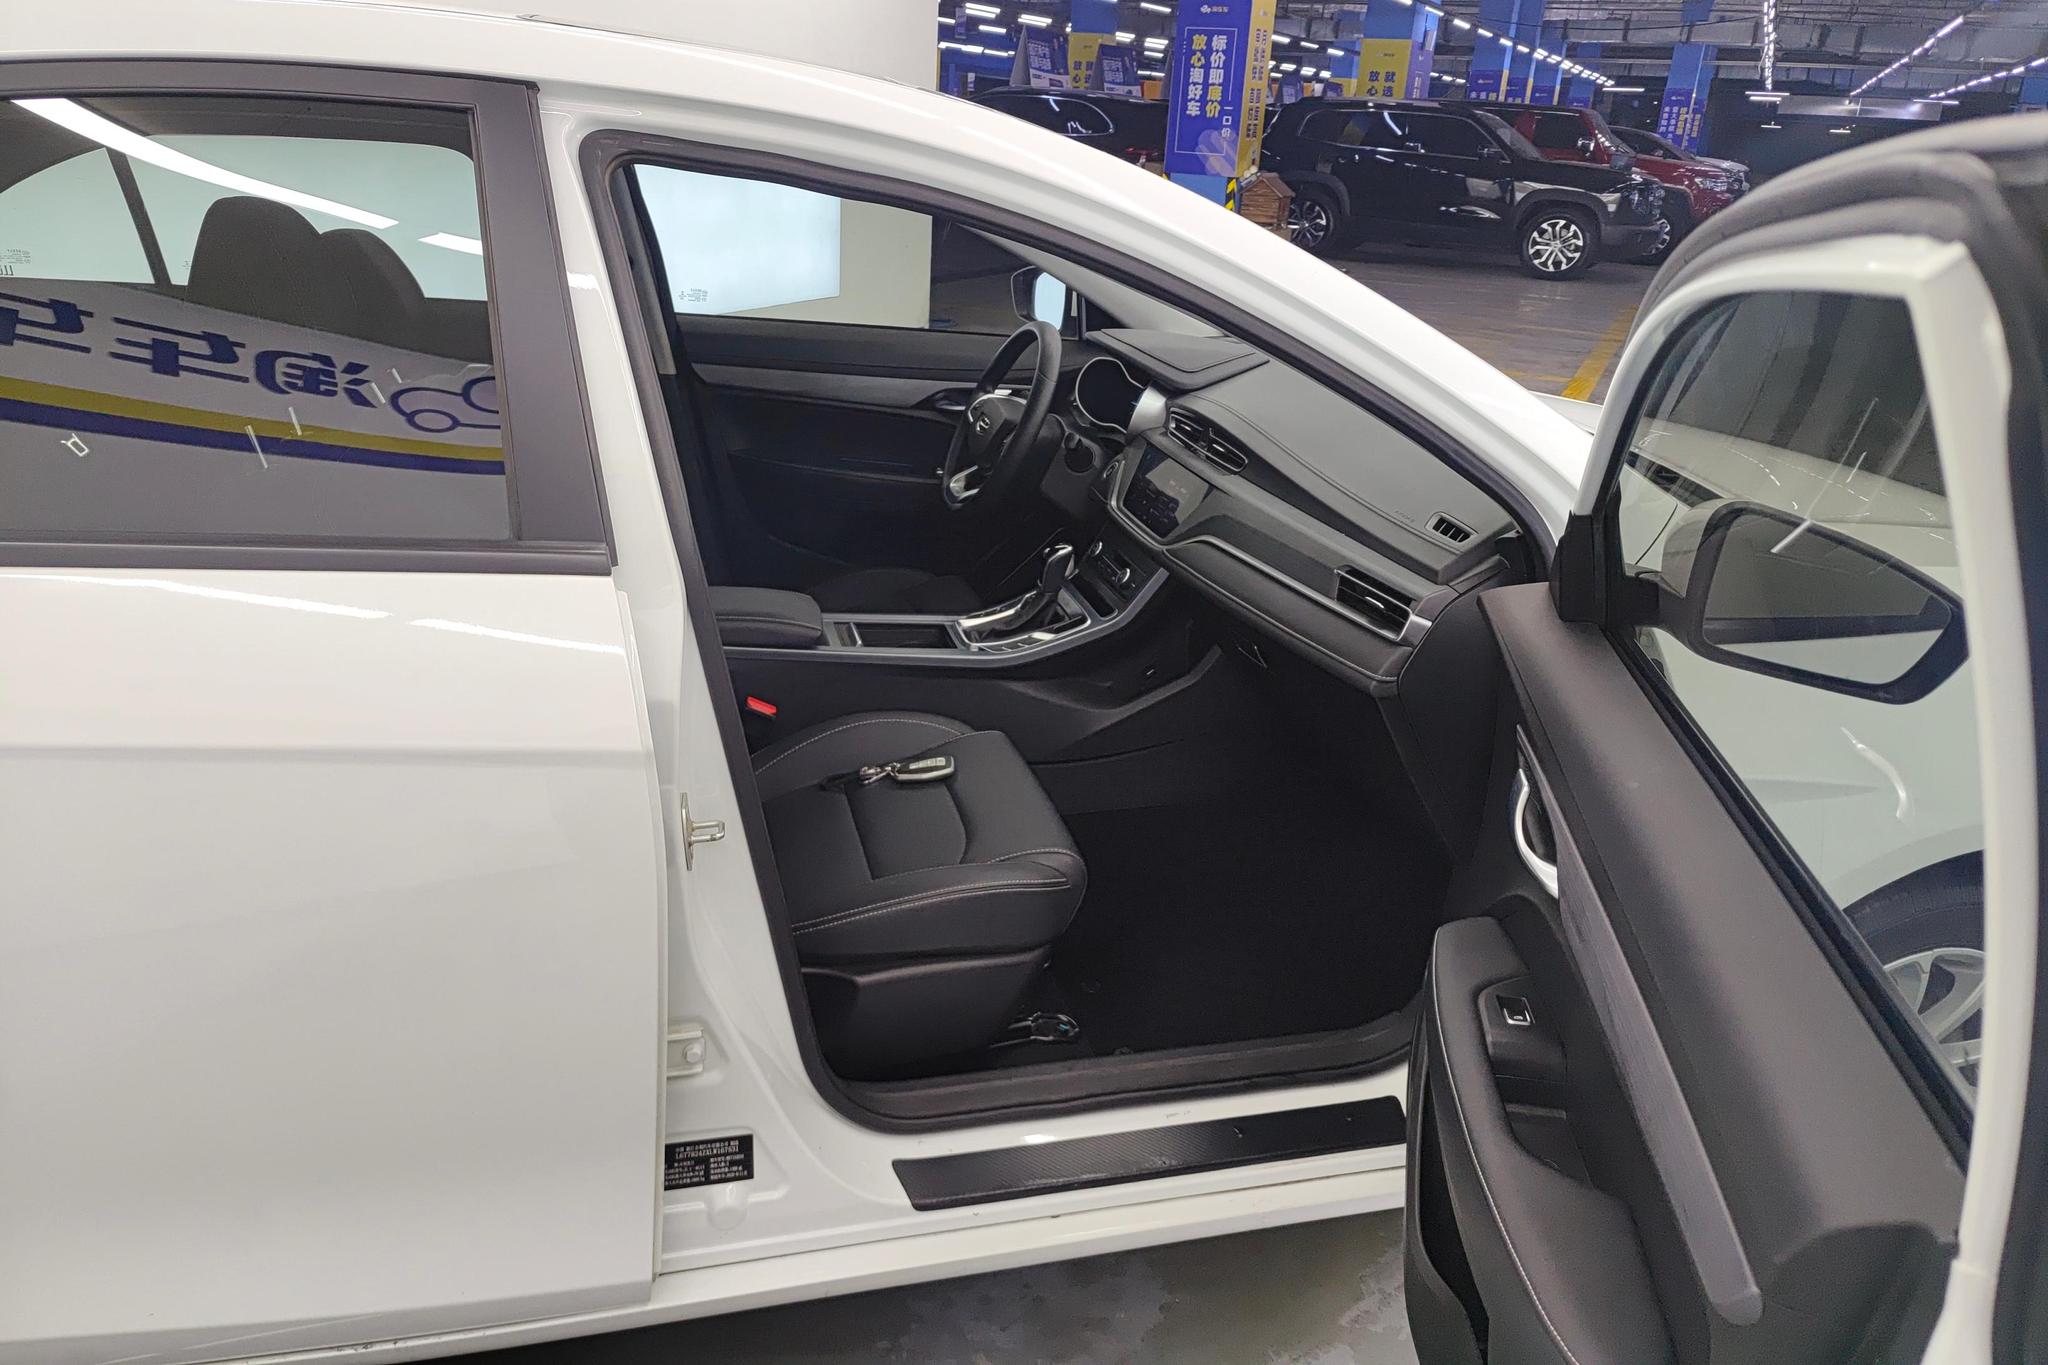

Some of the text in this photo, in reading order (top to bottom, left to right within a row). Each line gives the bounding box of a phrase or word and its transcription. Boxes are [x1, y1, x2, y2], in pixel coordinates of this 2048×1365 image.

[1186, 33, 1208, 117] 放心淘好车
[1205, 34, 1228, 118] 标价即底价
[1221, 106, 1234, 138] 一口价
